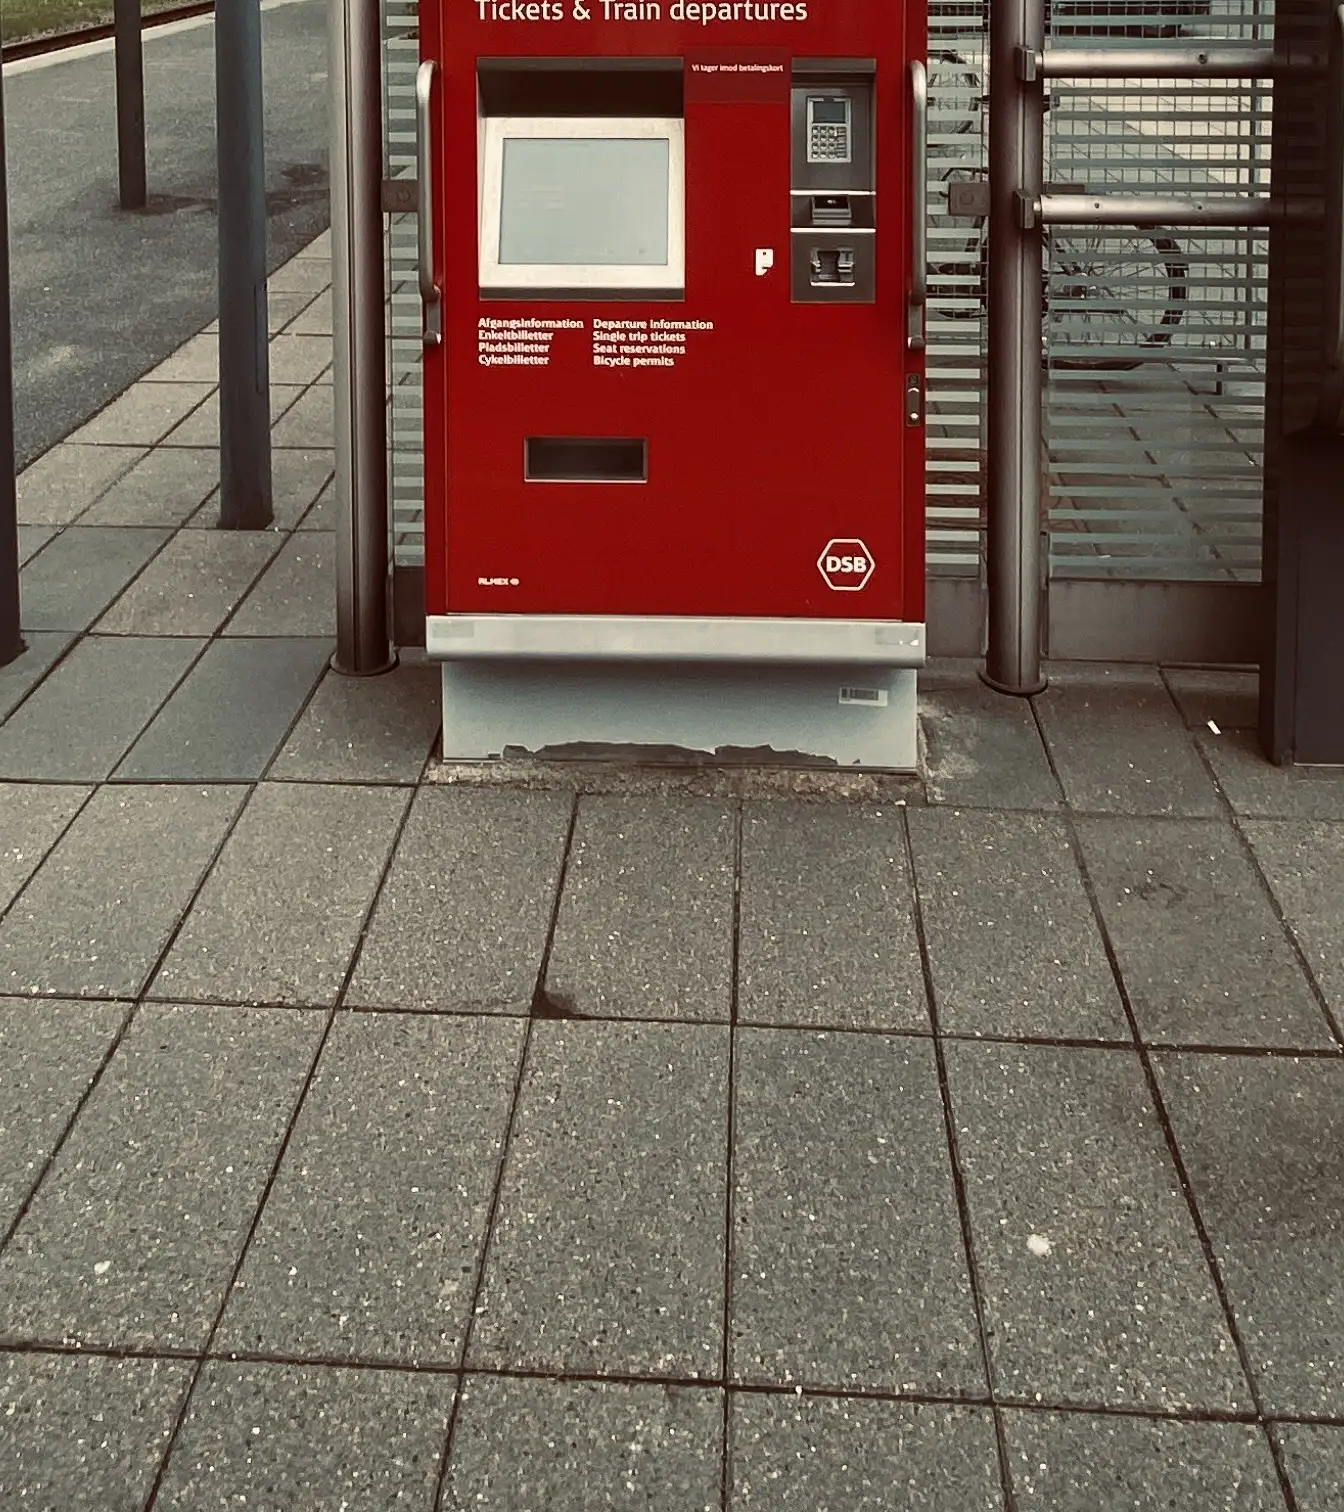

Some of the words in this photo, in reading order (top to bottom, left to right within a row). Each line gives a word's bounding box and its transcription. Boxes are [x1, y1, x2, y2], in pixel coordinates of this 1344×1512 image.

[691, 64, 700, 72] Vi
[700, 64, 719, 73] tager
[719, 64, 738, 72] imod
[477, 317, 585, 329] Afgangsinformation
[592, 318, 648, 330] Departure
[649, 318, 714, 330] information
[478, 329, 554, 341] Enkeltbilletter
[592, 330, 627, 342] Single
[628, 330, 649, 343] trip
[649, 330, 687, 342] tickets
[478, 341, 550, 353] Pladsbilletter
[592, 342, 618, 354] Seat
[619, 343, 686, 355] reservations
[478, 354, 550, 367] Cykelbilletter
[593, 354, 631, 368] Bicycle
[632, 355, 675, 368] permits
[826, 555, 867, 574] DSB
